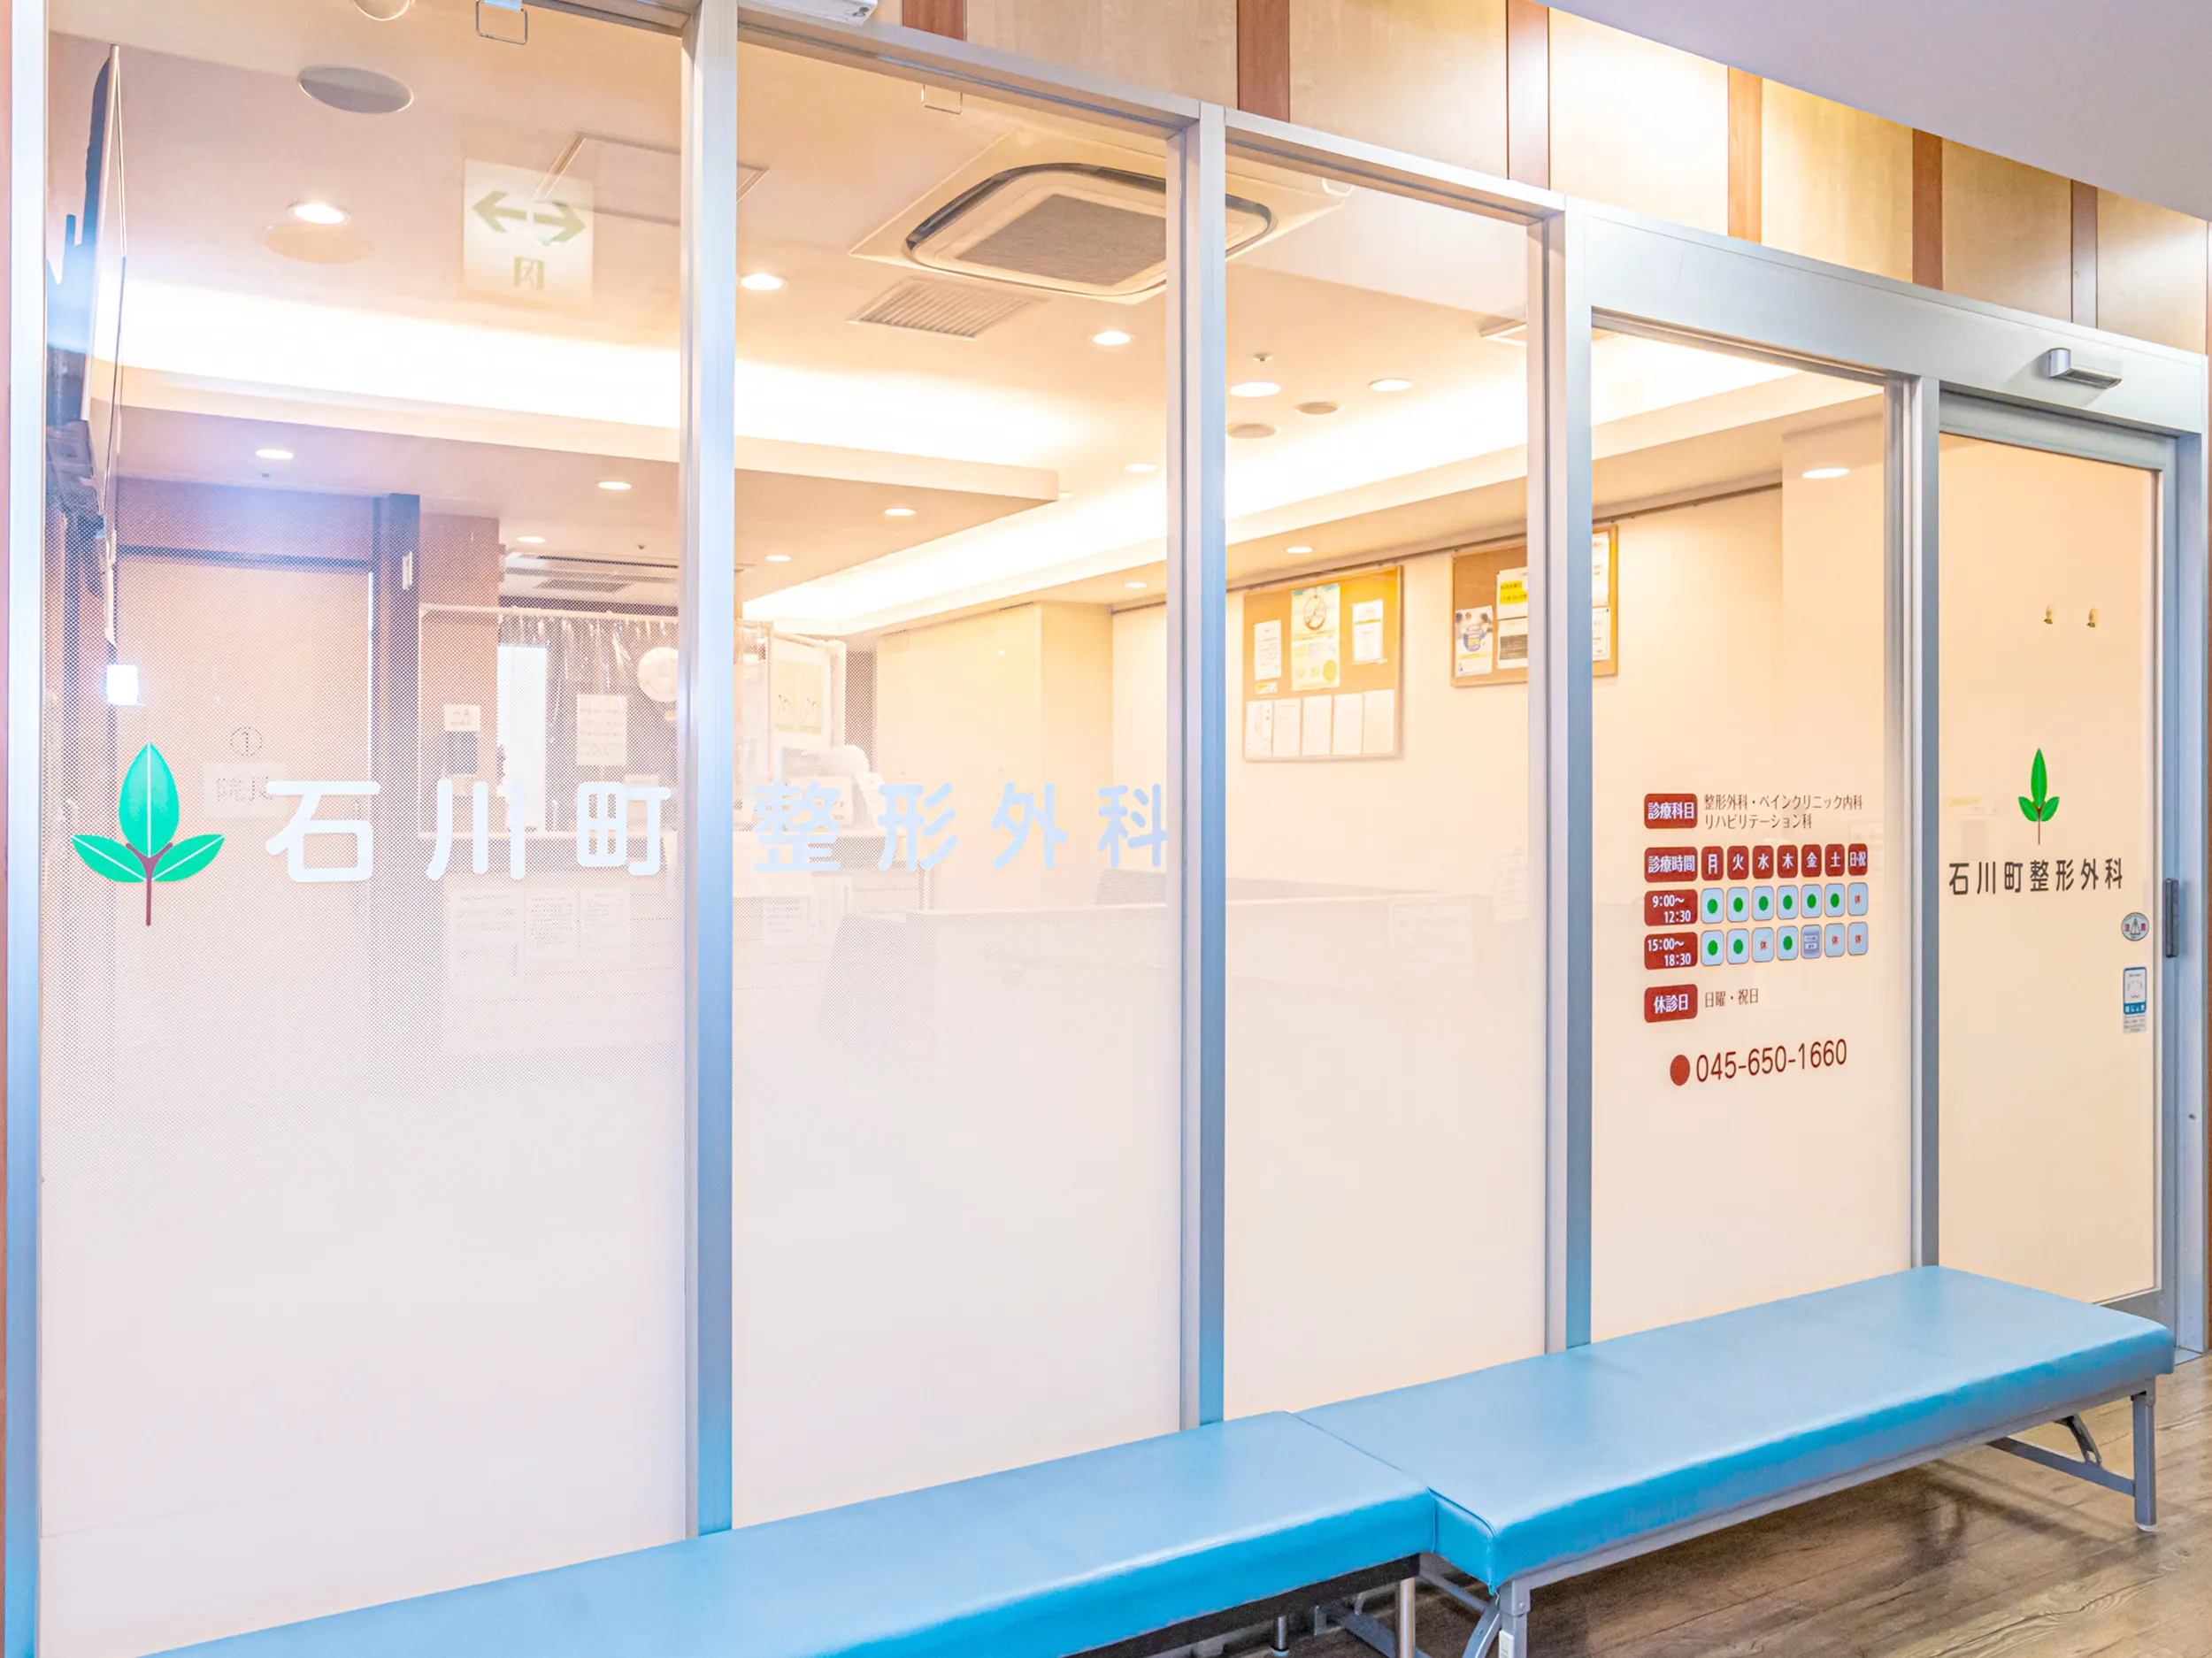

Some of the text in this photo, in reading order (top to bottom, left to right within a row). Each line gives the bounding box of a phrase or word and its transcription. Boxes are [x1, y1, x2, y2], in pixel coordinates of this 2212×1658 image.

[1647, 794, 1863, 820] 診療科目 整形外科・ペインクリニック内科
[265, 778, 1169, 884] 石川町 整形外科
[1704, 814, 1812, 830] リハビリテーション科
[1647, 855, 1695, 874] 診療時間
[1707, 854, 1718, 874] 月
[1732, 853, 1744, 871] 火
[1757, 853, 1770, 871] 水
[1782, 853, 1793, 870] 木
[1806, 852, 1818, 869] 金
[1830, 851, 1841, 868] 土
[1948, 857, 2124, 895] 石川町整形外科
[1663, 910, 1692, 924] 12:30
[1663, 953, 1692, 967] 18:30
[1653, 987, 1759, 1014] 休診日 日曜・祝日
[1695, 1038, 1847, 1083] 045-650-1660
